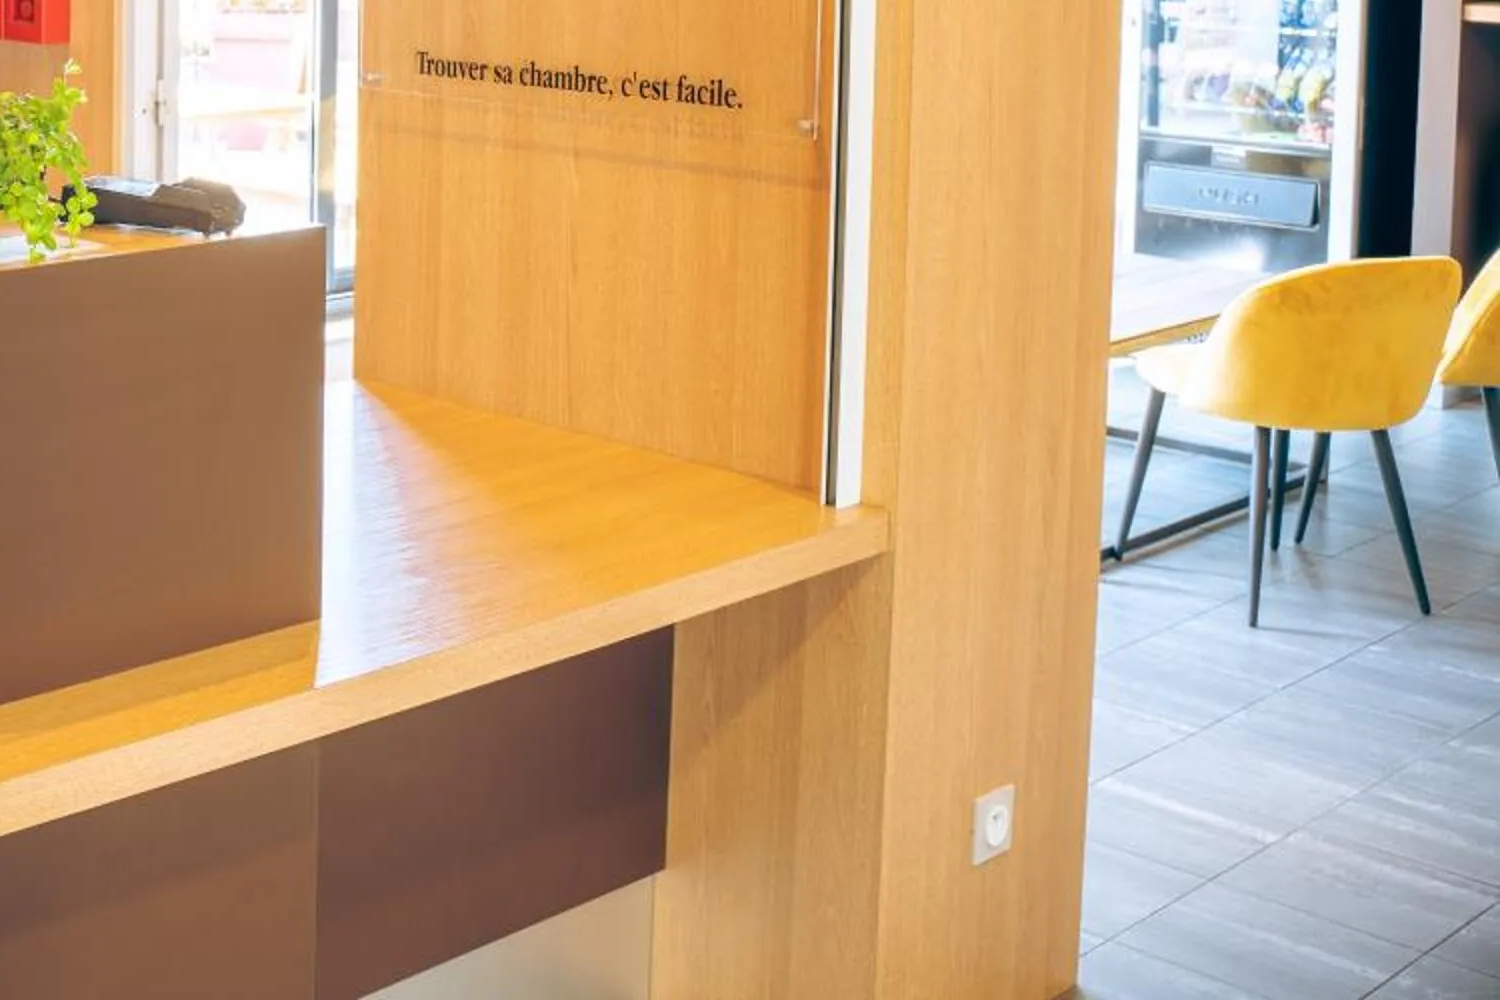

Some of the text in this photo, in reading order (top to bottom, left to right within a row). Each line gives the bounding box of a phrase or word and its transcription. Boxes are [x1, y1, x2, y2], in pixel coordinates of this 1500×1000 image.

[416, 51, 743, 109] Trouver sa chambre, c'est facile.
